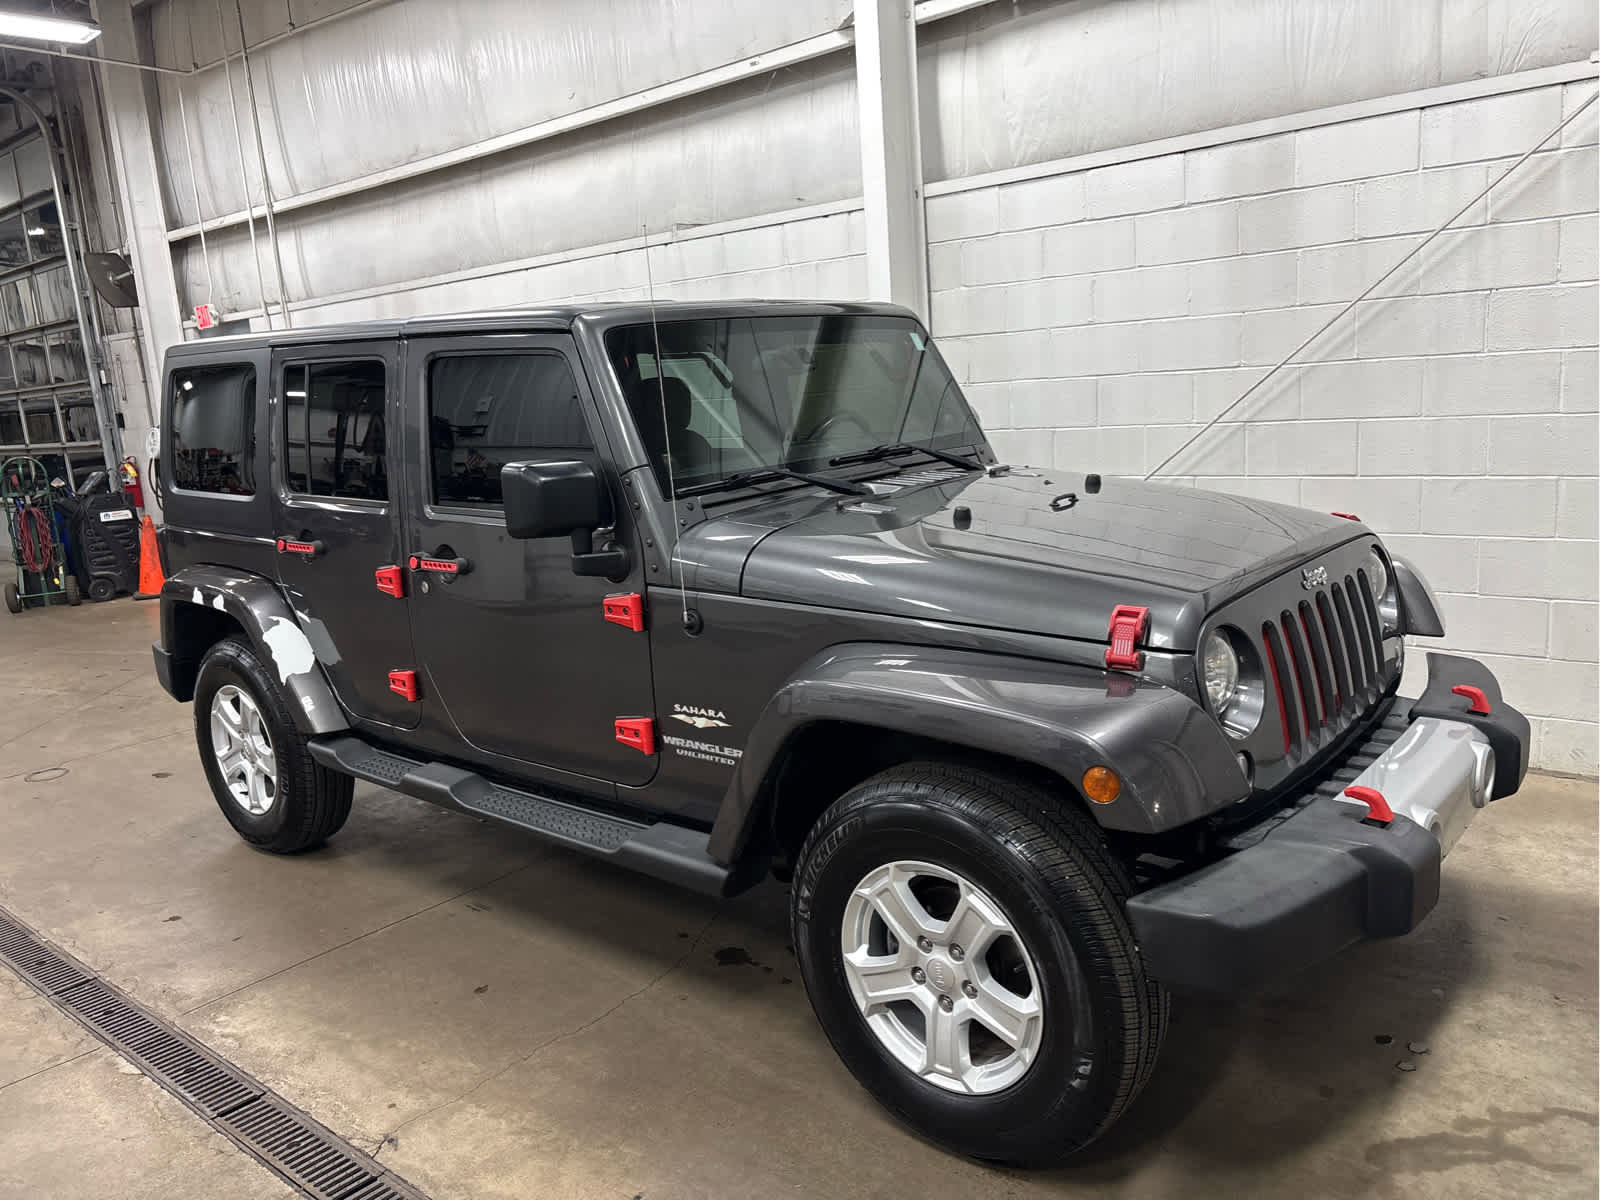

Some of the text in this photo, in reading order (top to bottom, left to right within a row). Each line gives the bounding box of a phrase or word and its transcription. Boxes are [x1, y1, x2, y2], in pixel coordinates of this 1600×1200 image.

[1302, 566, 1327, 590] Jeep
[673, 703, 726, 719] SAHARA
[662, 735, 744, 758] WRANGLER
[675, 748, 735, 766] UNLIMITED
